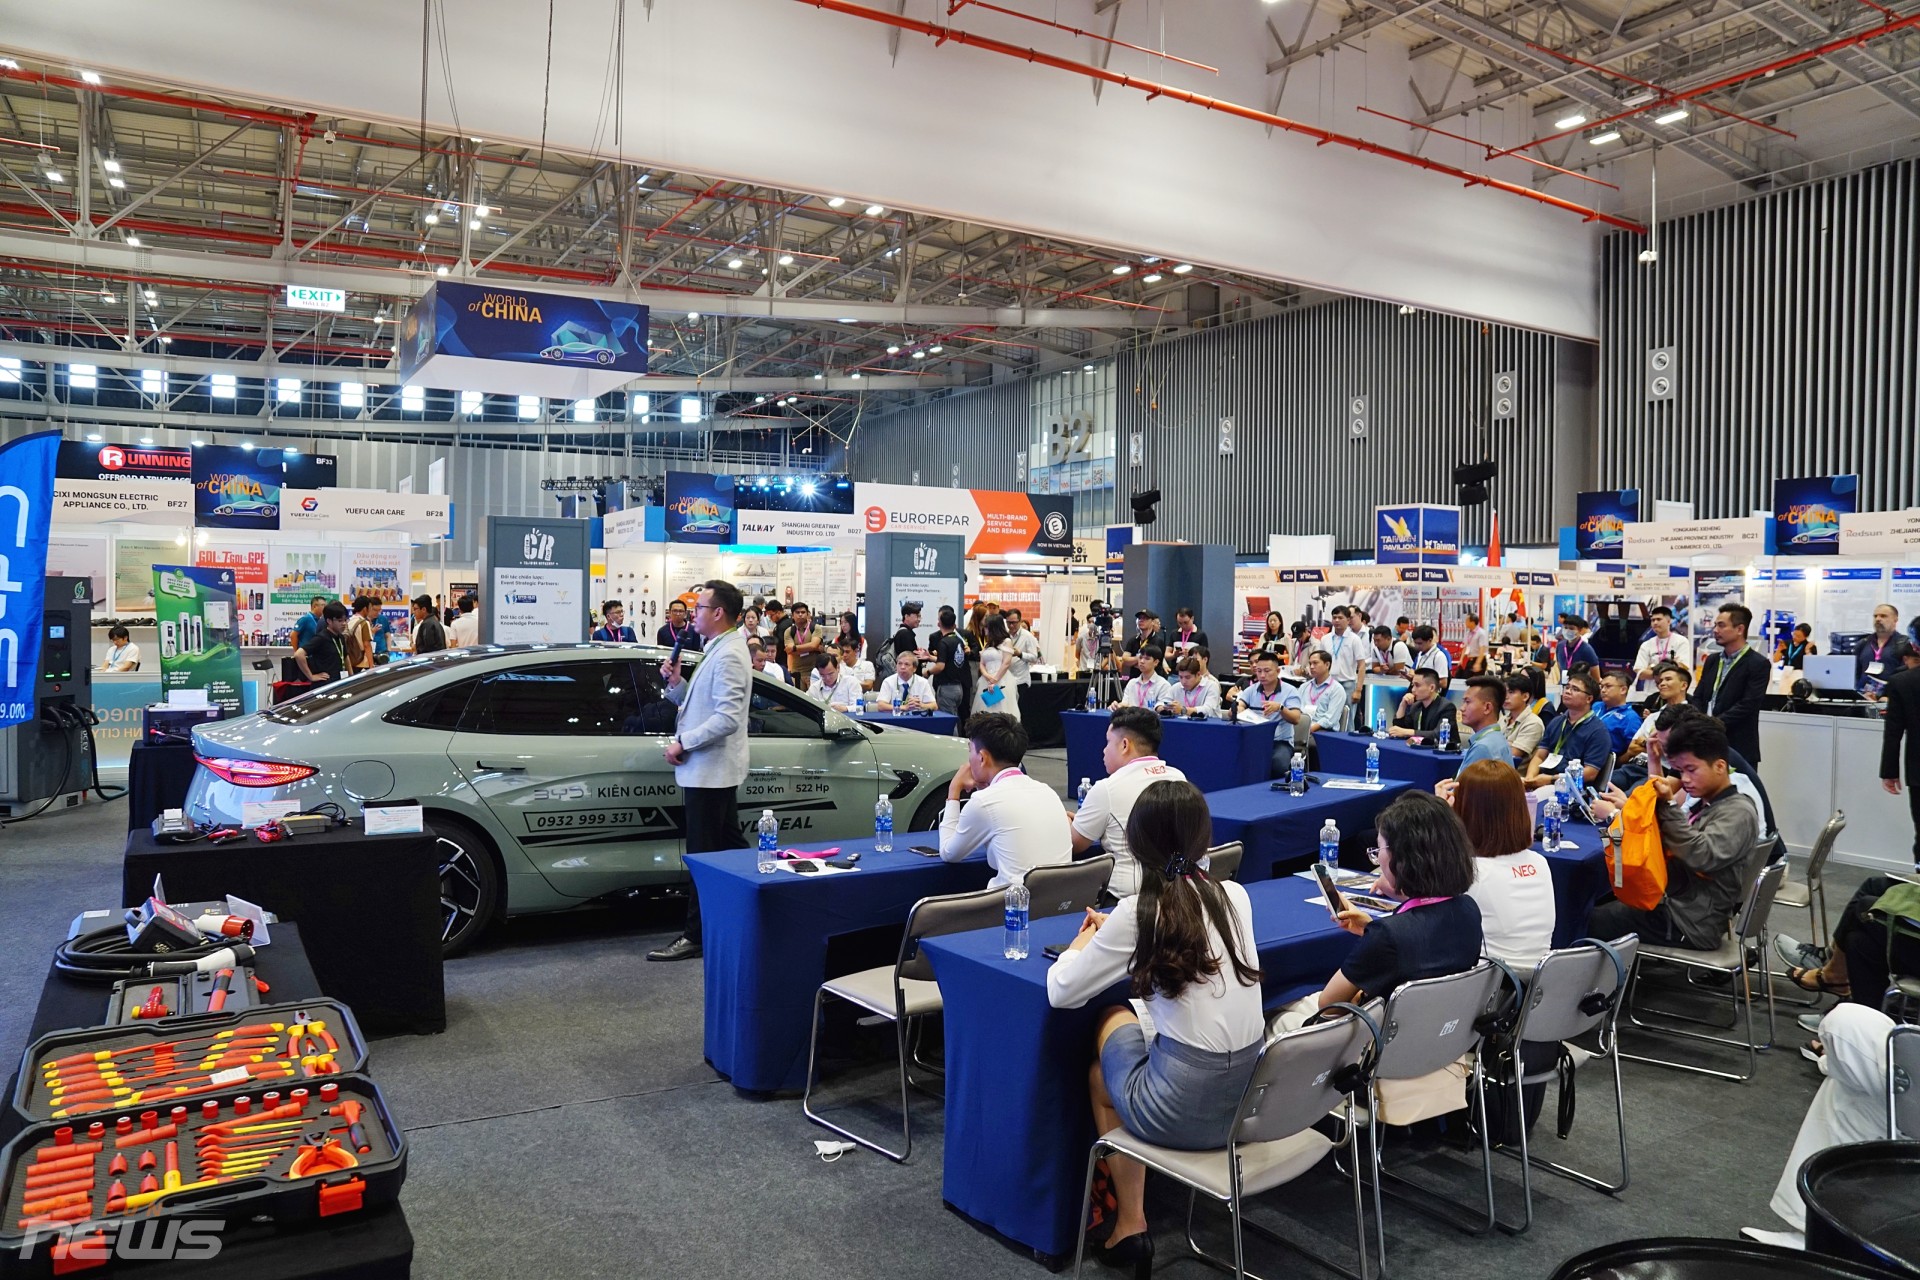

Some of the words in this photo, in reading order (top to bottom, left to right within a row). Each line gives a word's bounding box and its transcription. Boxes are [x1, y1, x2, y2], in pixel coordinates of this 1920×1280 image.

[299, 290, 332, 302] EXIT
[483, 292, 527, 309] WORLD
[468, 301, 480, 312] of
[481, 302, 543, 324] CHINA
[1047, 410, 1091, 465] B2
[103, 447, 191, 468] RUNNING
[316, 457, 333, 466] BF33
[210, 473, 248, 482] WORLD
[197, 480, 208, 490] of
[208, 481, 262, 496] CHINA
[72, 491, 117, 500] MONGSUN
[119, 493, 159, 501] ELECTRIC
[679, 496, 708, 504] WORLD
[63, 500, 112, 509] APPLIANCE
[114, 502, 130, 511] CO.,
[132, 503, 149, 511] LTD.
[167, 500, 188, 508] BF27
[669, 503, 678, 511] of
[677, 502, 720, 516] CHINA
[1789, 504, 1823, 514] WORLD
[345, 507, 364, 515] YUEFU
[365, 508, 379, 516] CAR
[380, 508, 405, 516] CARE
[987, 513, 1028, 521] MULTI-BRAND
[1778, 512, 1788, 522] of
[1788, 510, 1836, 524] CHINA
[890, 512, 970, 526] EUROREPAR
[742, 524, 775, 532] TALWAY
[781, 521, 811, 529] SHANGHAI
[1587, 521, 1624, 533] CHINA
[1380, 534, 1416, 543] TAIWAN
[1382, 543, 1416, 551] PAVILION
[1432, 540, 1456, 551] Taiwan
[286, 553, 326, 569] NEV
[597, 785, 634, 798] KIÊN
[636, 784, 676, 798] GIANG
[746, 785, 765, 795] 520
[767, 784, 785, 795] Km
[795, 783, 813, 793] 522
[815, 783, 830, 795] Hp
[537, 815, 575, 828] 0932
[578, 813, 608, 826] 999
[610, 812, 633, 824] 331
[1511, 864, 1537, 878] NEG
